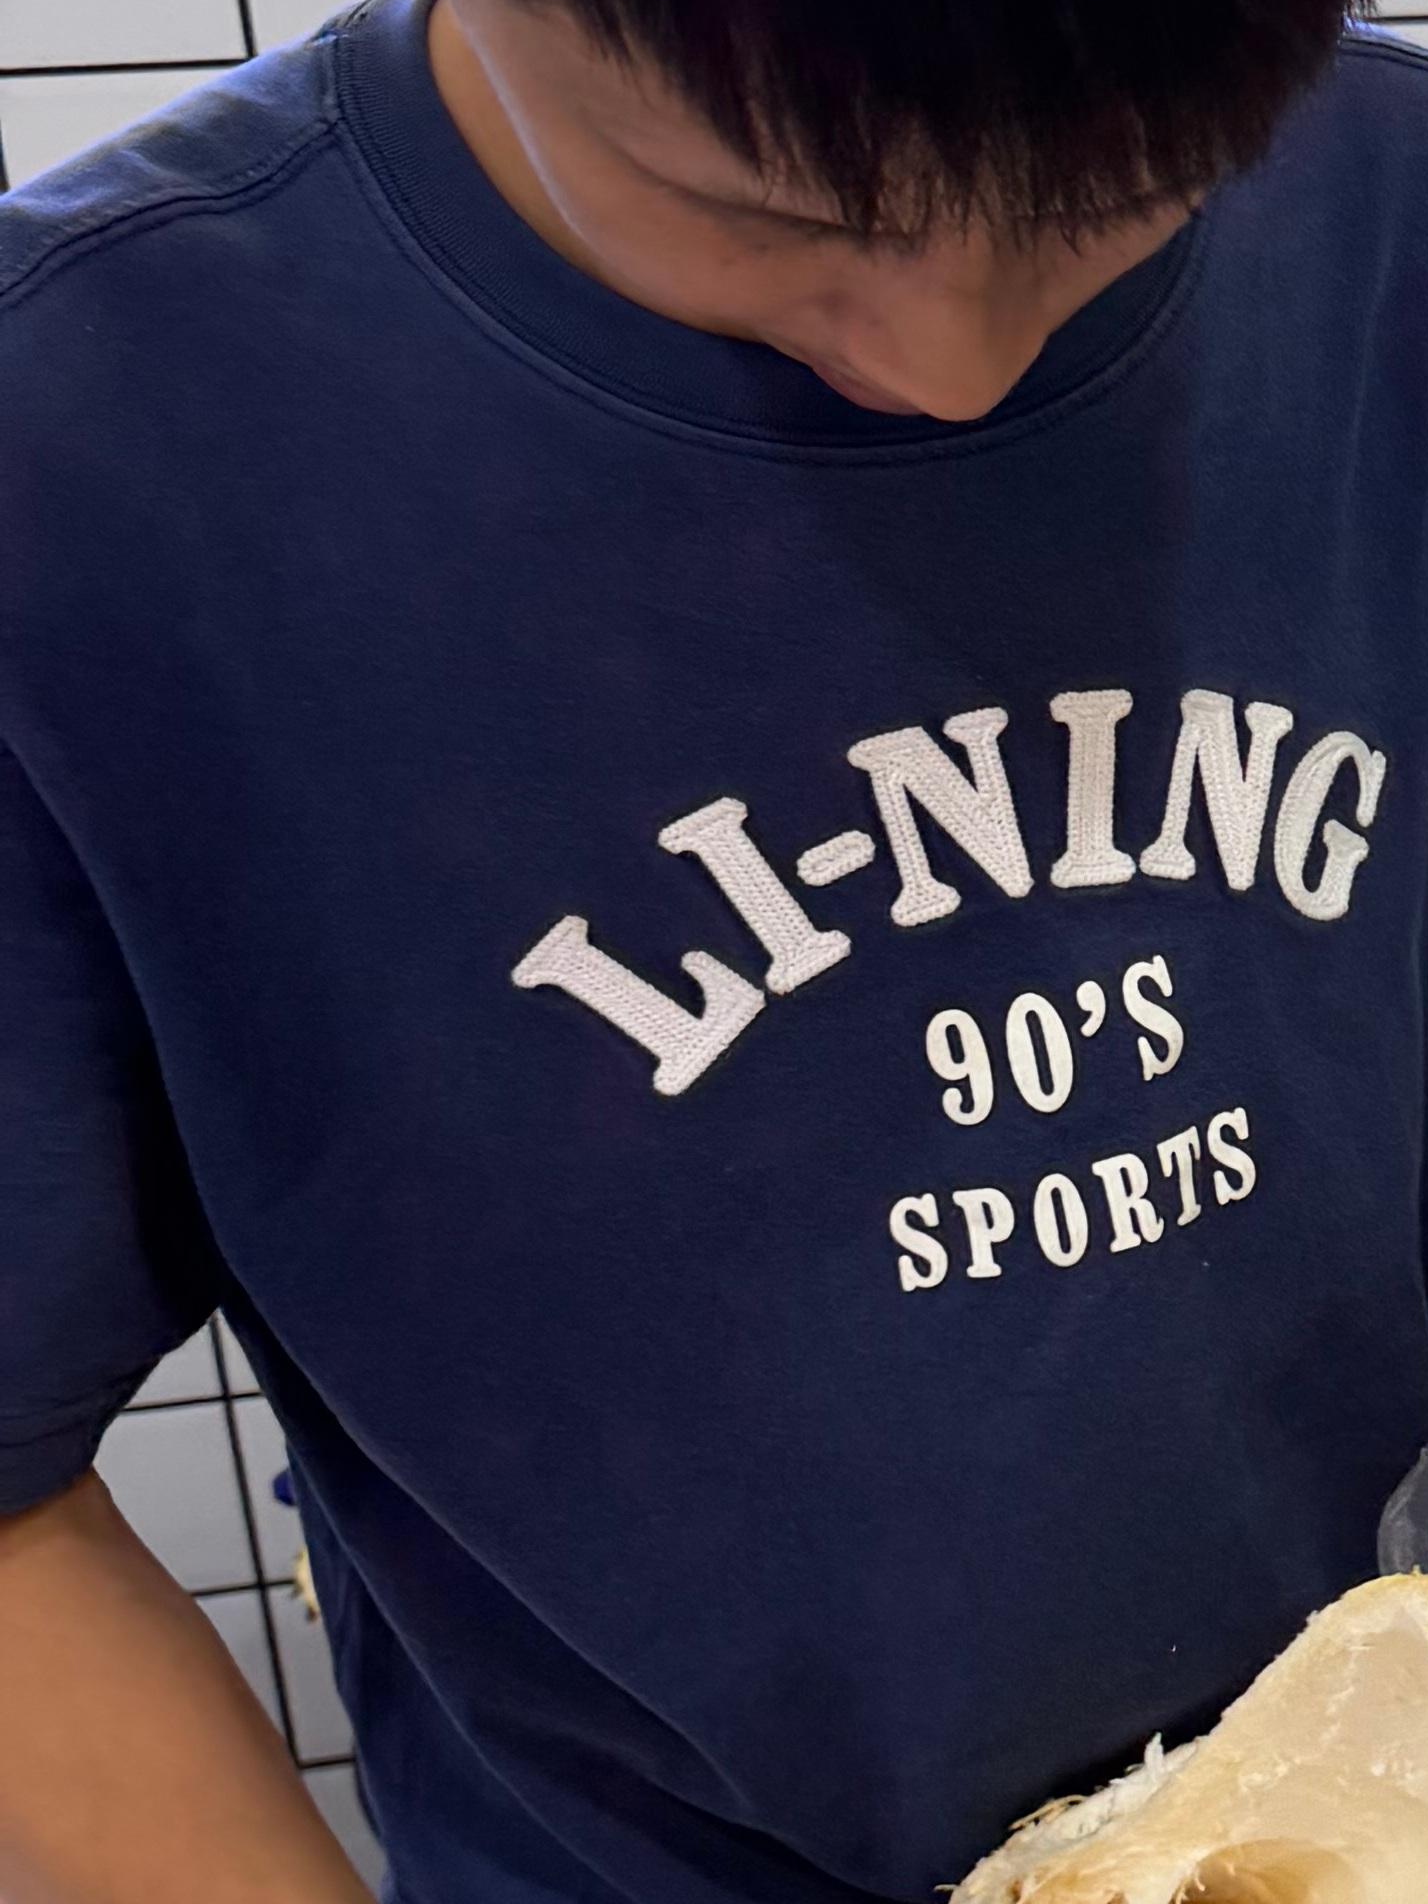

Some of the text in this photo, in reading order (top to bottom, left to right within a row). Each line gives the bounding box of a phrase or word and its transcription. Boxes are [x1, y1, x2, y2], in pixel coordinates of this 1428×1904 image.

[511, 688, 1387, 1096] LI-NING
[925, 954, 1186, 1126] 90'S
[889, 1107, 1257, 1292] SPORTS
